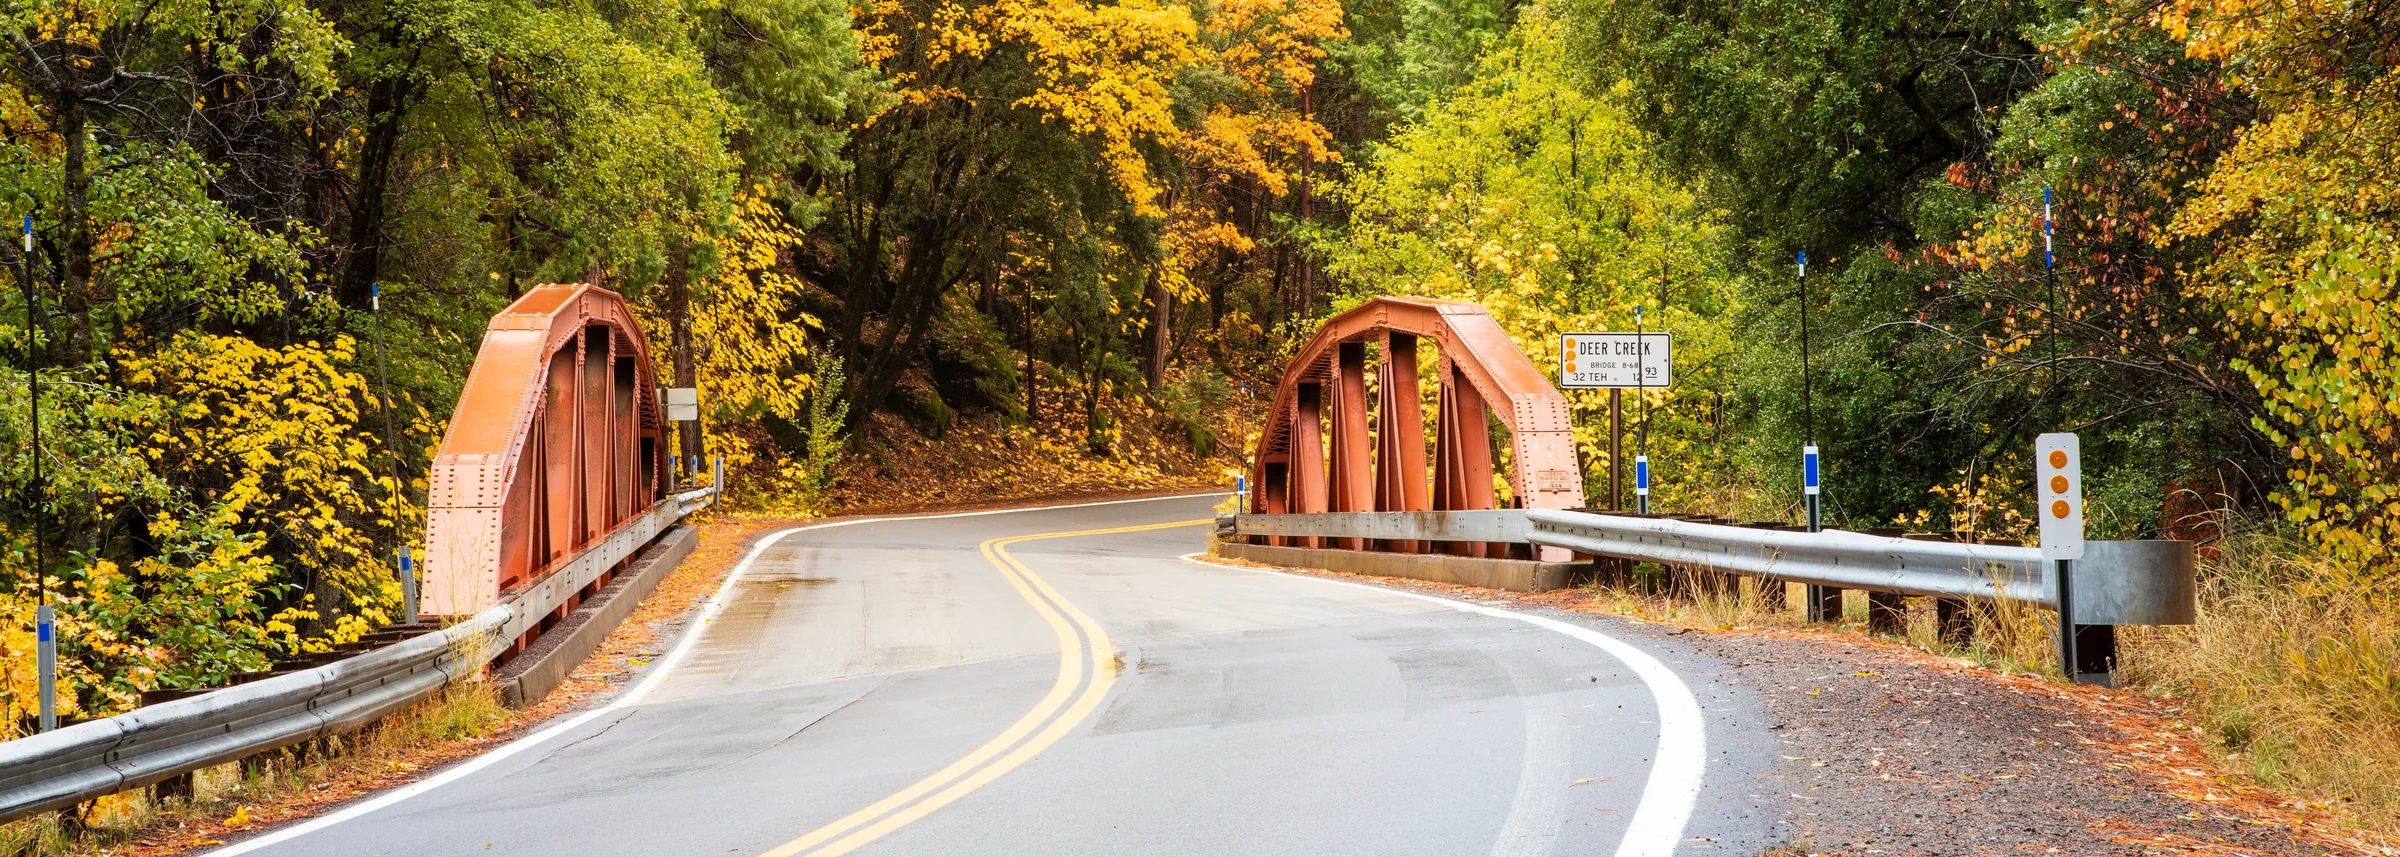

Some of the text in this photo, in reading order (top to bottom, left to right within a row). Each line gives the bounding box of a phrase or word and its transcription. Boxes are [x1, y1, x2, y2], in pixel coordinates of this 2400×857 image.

[1580, 342, 1651, 355] DEER CREEK
[1573, 373, 1585, 381] 32
[1589, 373, 1607, 381] TEH
[1645, 367, 1657, 375] 93
